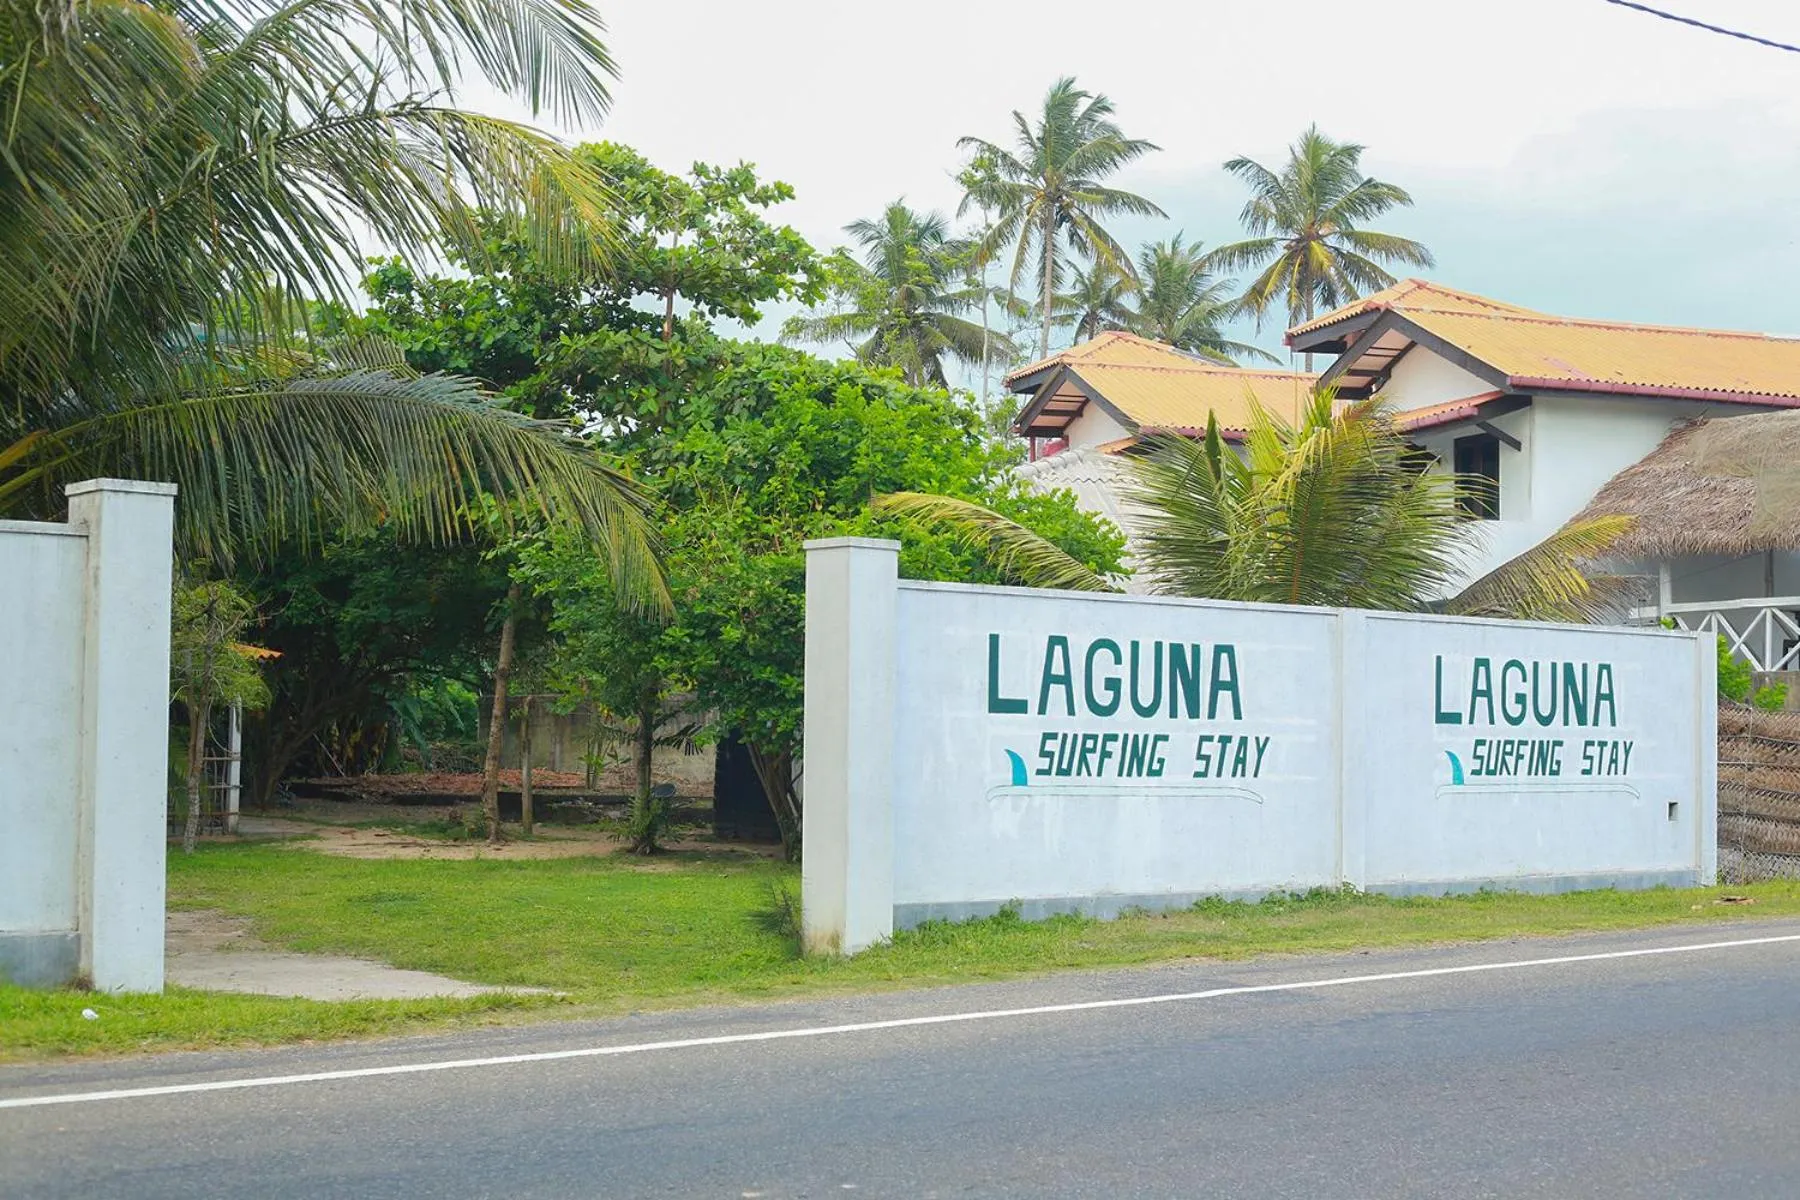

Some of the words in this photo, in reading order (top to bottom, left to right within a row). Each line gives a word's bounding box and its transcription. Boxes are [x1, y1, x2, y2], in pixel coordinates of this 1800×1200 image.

[988, 633, 1243, 721] LAGUNA
[1434, 655, 1617, 727] LAGUNA
[1035, 732, 1170, 778] SURFING
[1193, 735, 1270, 779] STAY
[1470, 739, 1564, 777] SURFING
[1580, 740, 1634, 776] STAY
